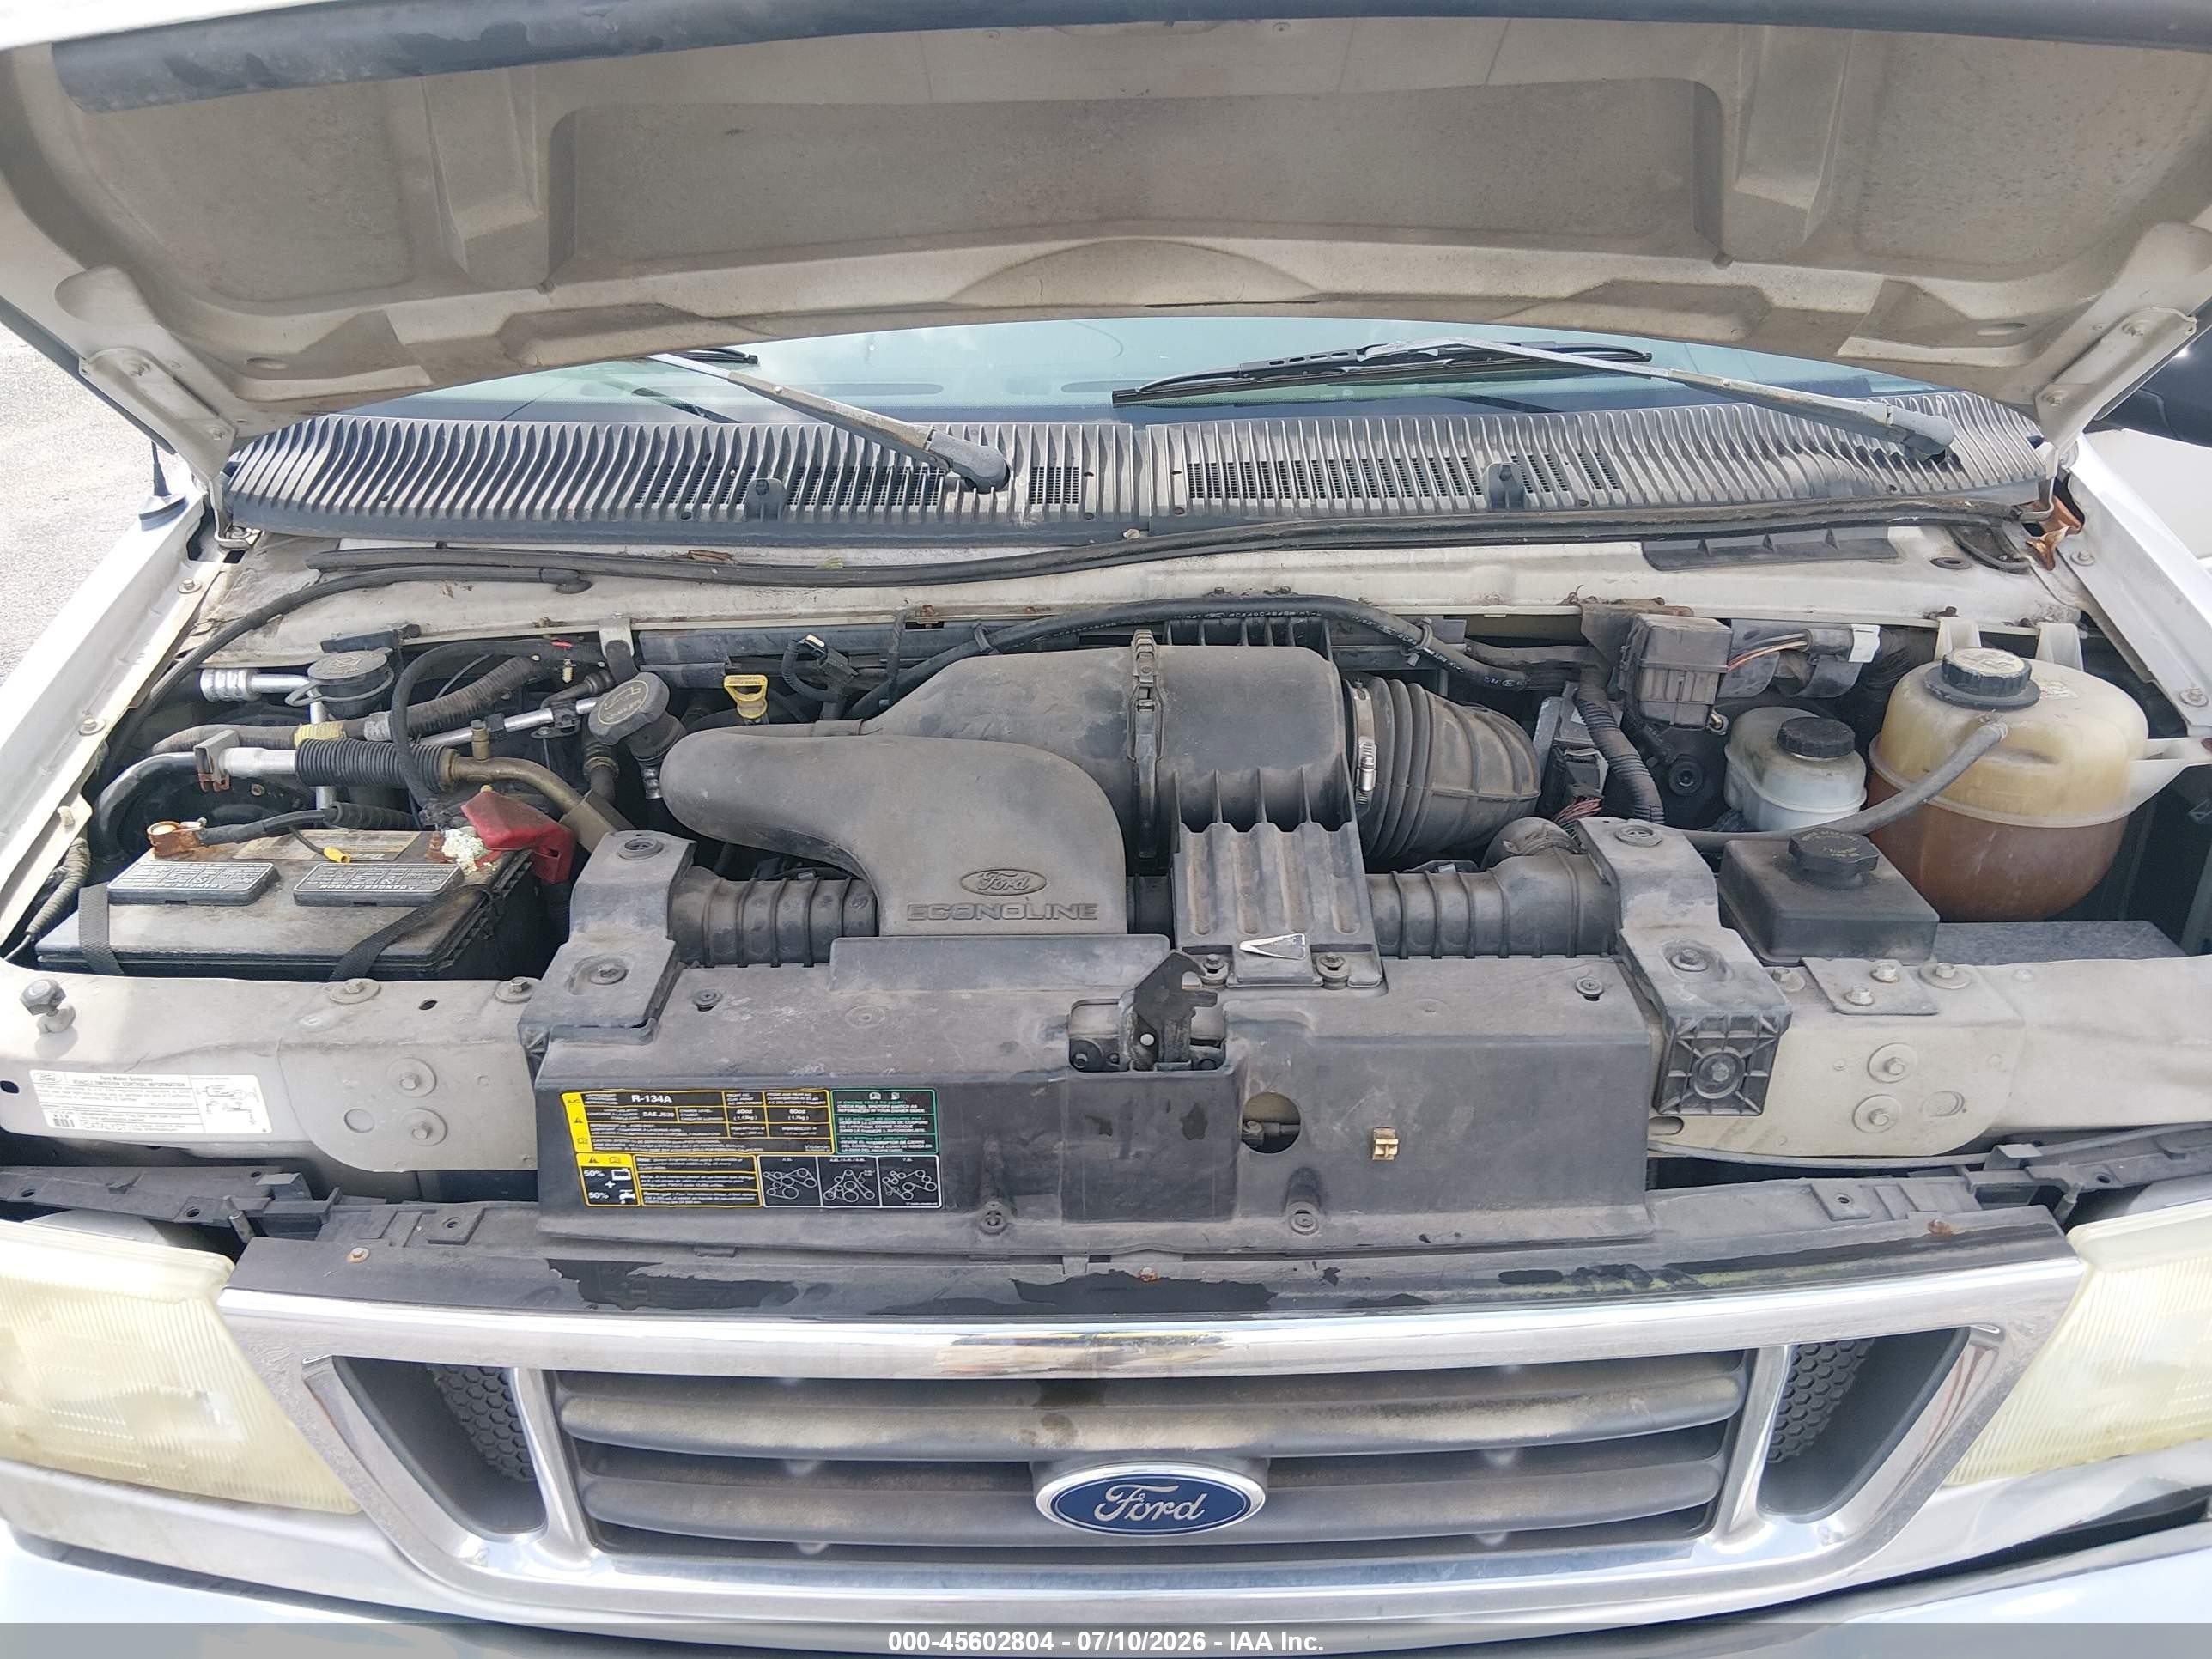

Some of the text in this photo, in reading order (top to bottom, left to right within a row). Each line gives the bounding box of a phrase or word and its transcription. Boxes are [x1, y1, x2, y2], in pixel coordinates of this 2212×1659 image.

[978, 872, 1031, 890] Ford
[907, 903, 1098, 921] ECONOLINE
[631, 1095, 672, 1103] R-134A
[1094, 1484, 1207, 1522] Ford
